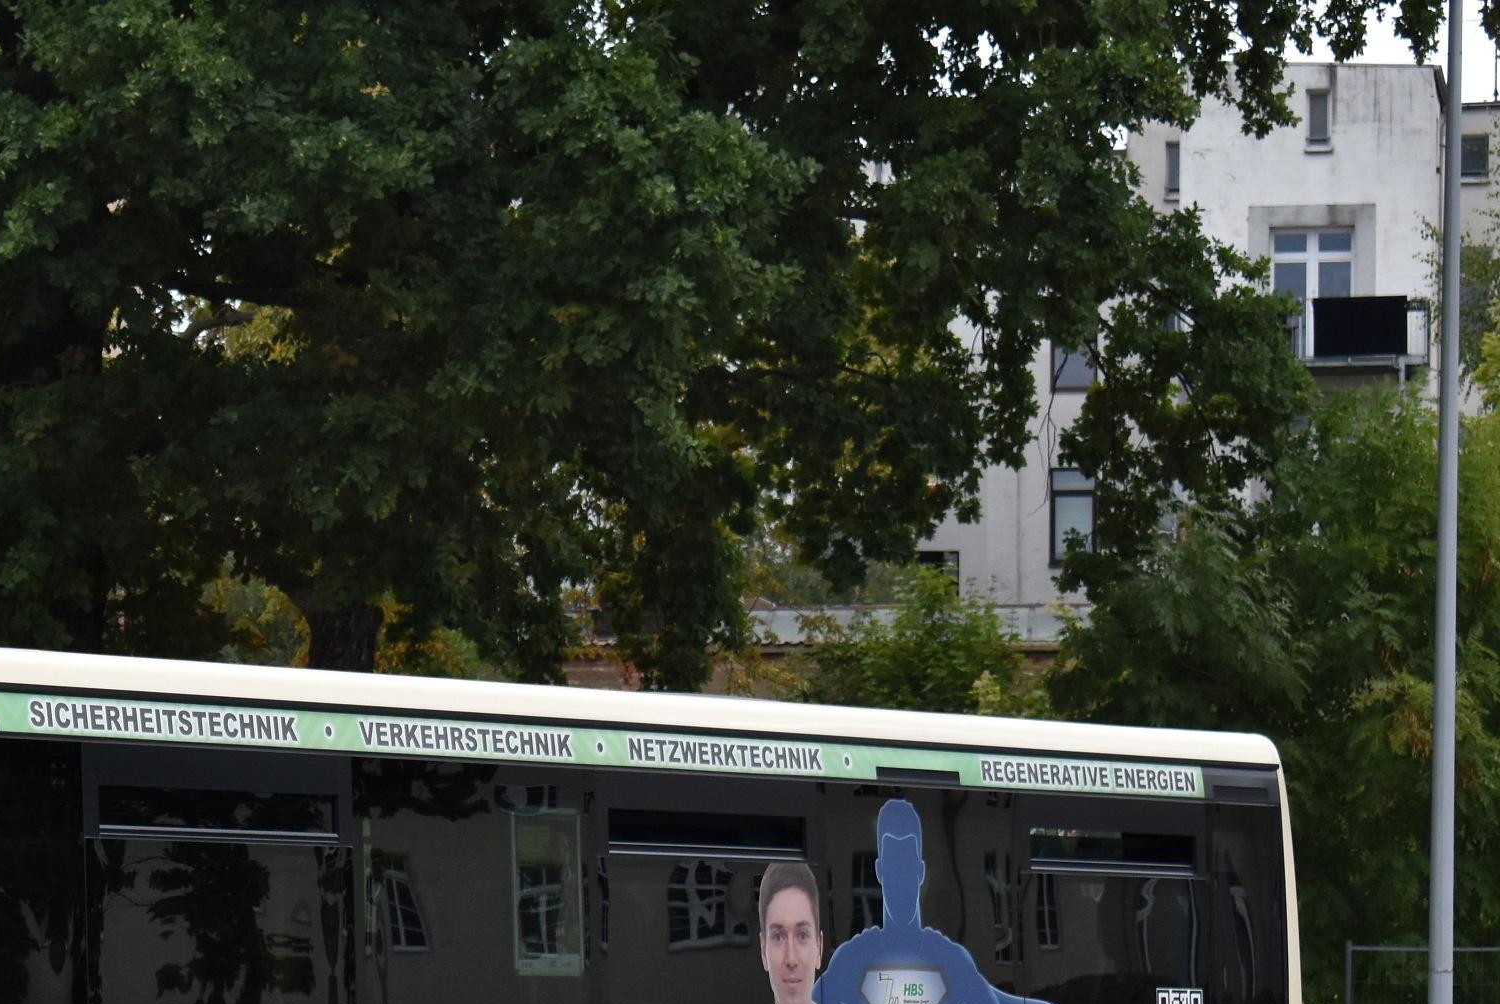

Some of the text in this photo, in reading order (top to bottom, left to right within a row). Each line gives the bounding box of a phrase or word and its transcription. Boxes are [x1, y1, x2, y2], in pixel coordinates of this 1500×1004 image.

[29, 700, 298, 742] SICHERHEITSTECHNIK
[358, 721, 573, 758] VERKEHRSTECHNIK
[627, 738, 823, 771] NETZWERKTECHNIK
[981, 761, 1110, 788] REGENERATIVE
[1116, 768, 1197, 792] ENERGIEN
[903, 984, 924, 996] HBS
